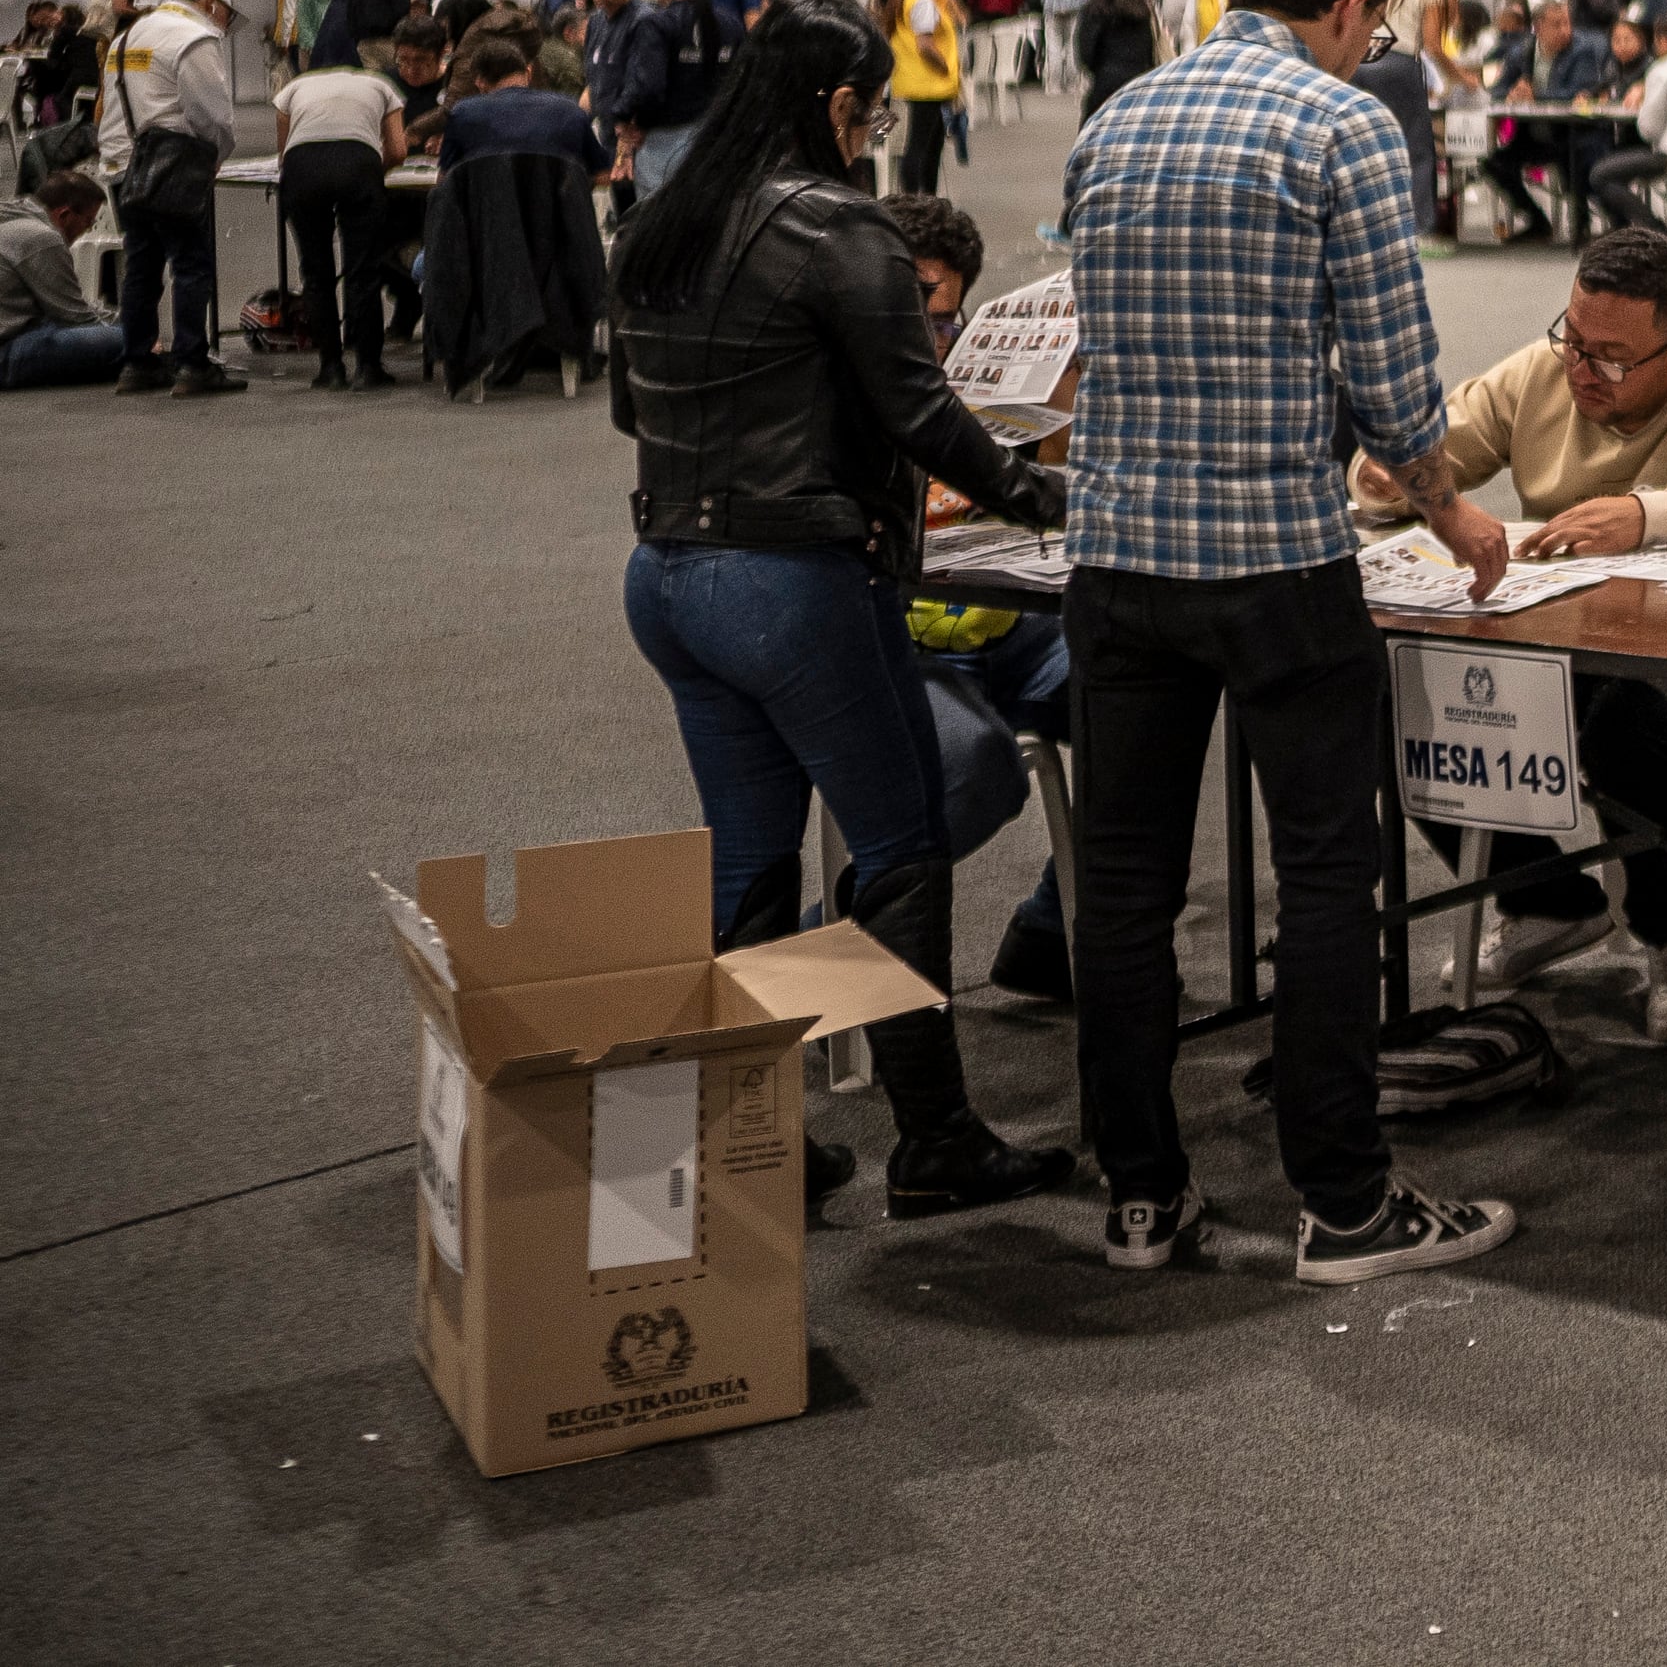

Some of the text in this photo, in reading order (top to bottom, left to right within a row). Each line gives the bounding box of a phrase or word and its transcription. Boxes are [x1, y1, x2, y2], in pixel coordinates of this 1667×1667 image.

[1444, 706, 1517, 725] REGISTRADURÍA
[1404, 738, 1566, 796] MESA 149
[547, 1376, 750, 1430] REGISTRADURÍA
[623, 1413, 652, 1427] DEL
[713, 1395, 750, 1409] CIVIL
